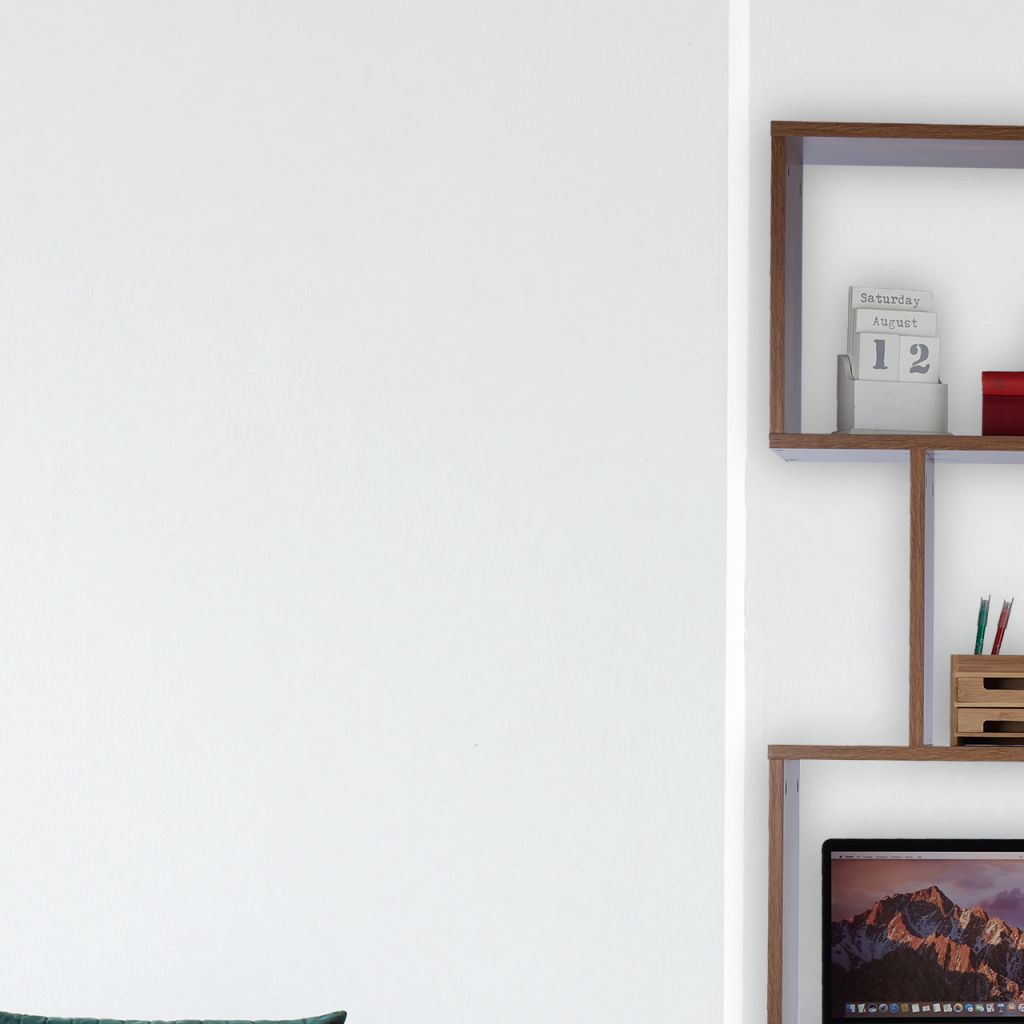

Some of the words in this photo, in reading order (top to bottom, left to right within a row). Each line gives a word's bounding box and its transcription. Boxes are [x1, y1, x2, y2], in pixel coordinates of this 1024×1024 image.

[860, 292, 920, 309] Saturday
[872, 316, 918, 330] August
[872, 338, 888, 370] 1
[909, 343, 930, 374] 2
